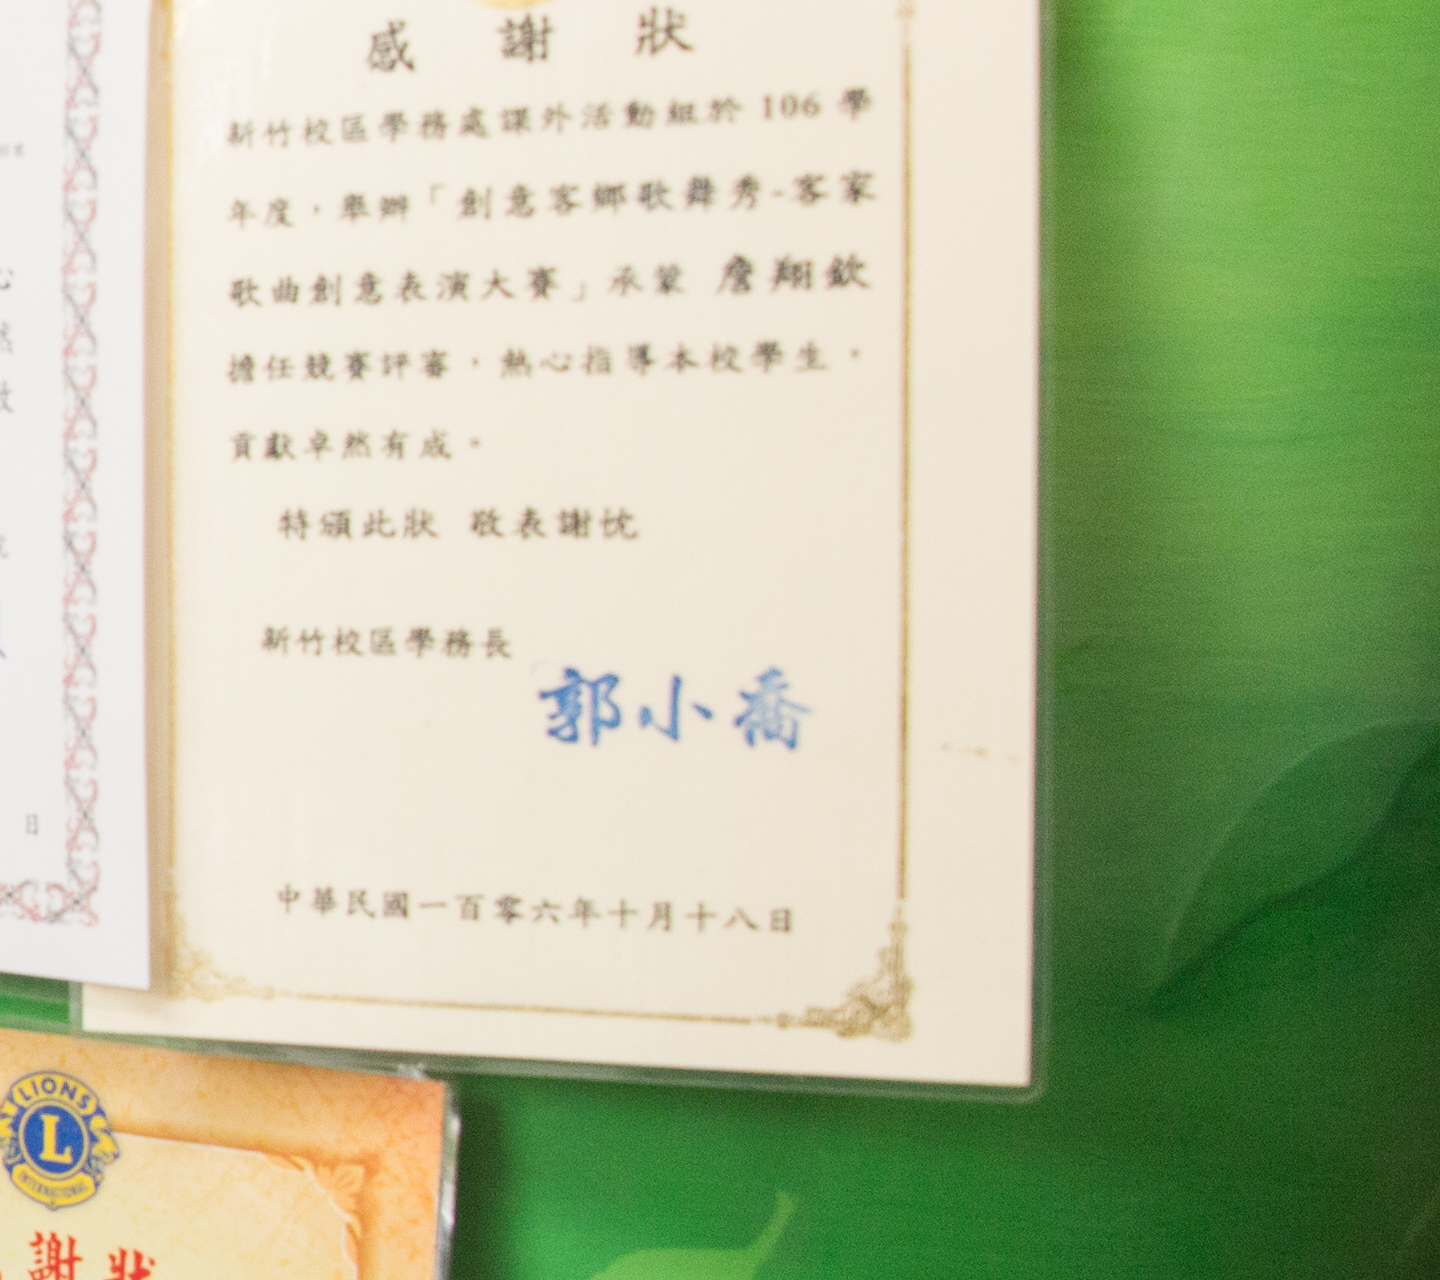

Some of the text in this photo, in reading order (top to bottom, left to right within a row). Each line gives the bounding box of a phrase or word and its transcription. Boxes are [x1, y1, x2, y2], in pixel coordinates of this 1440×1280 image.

[364, 5, 696, 74] 感謝狀
[761, 86, 875, 123] 106 學
[716, 252, 872, 296] 詹翔欽
[276, 506, 641, 543] 特頒此狀 敬表謝忱
[260, 626, 515, 661] 新竹校區學務長
[276, 883, 797, 935] 中華民國一百零六年十月十八日
[18, 1078, 91, 1109] LIONS
[39, 1113, 74, 1164] L
